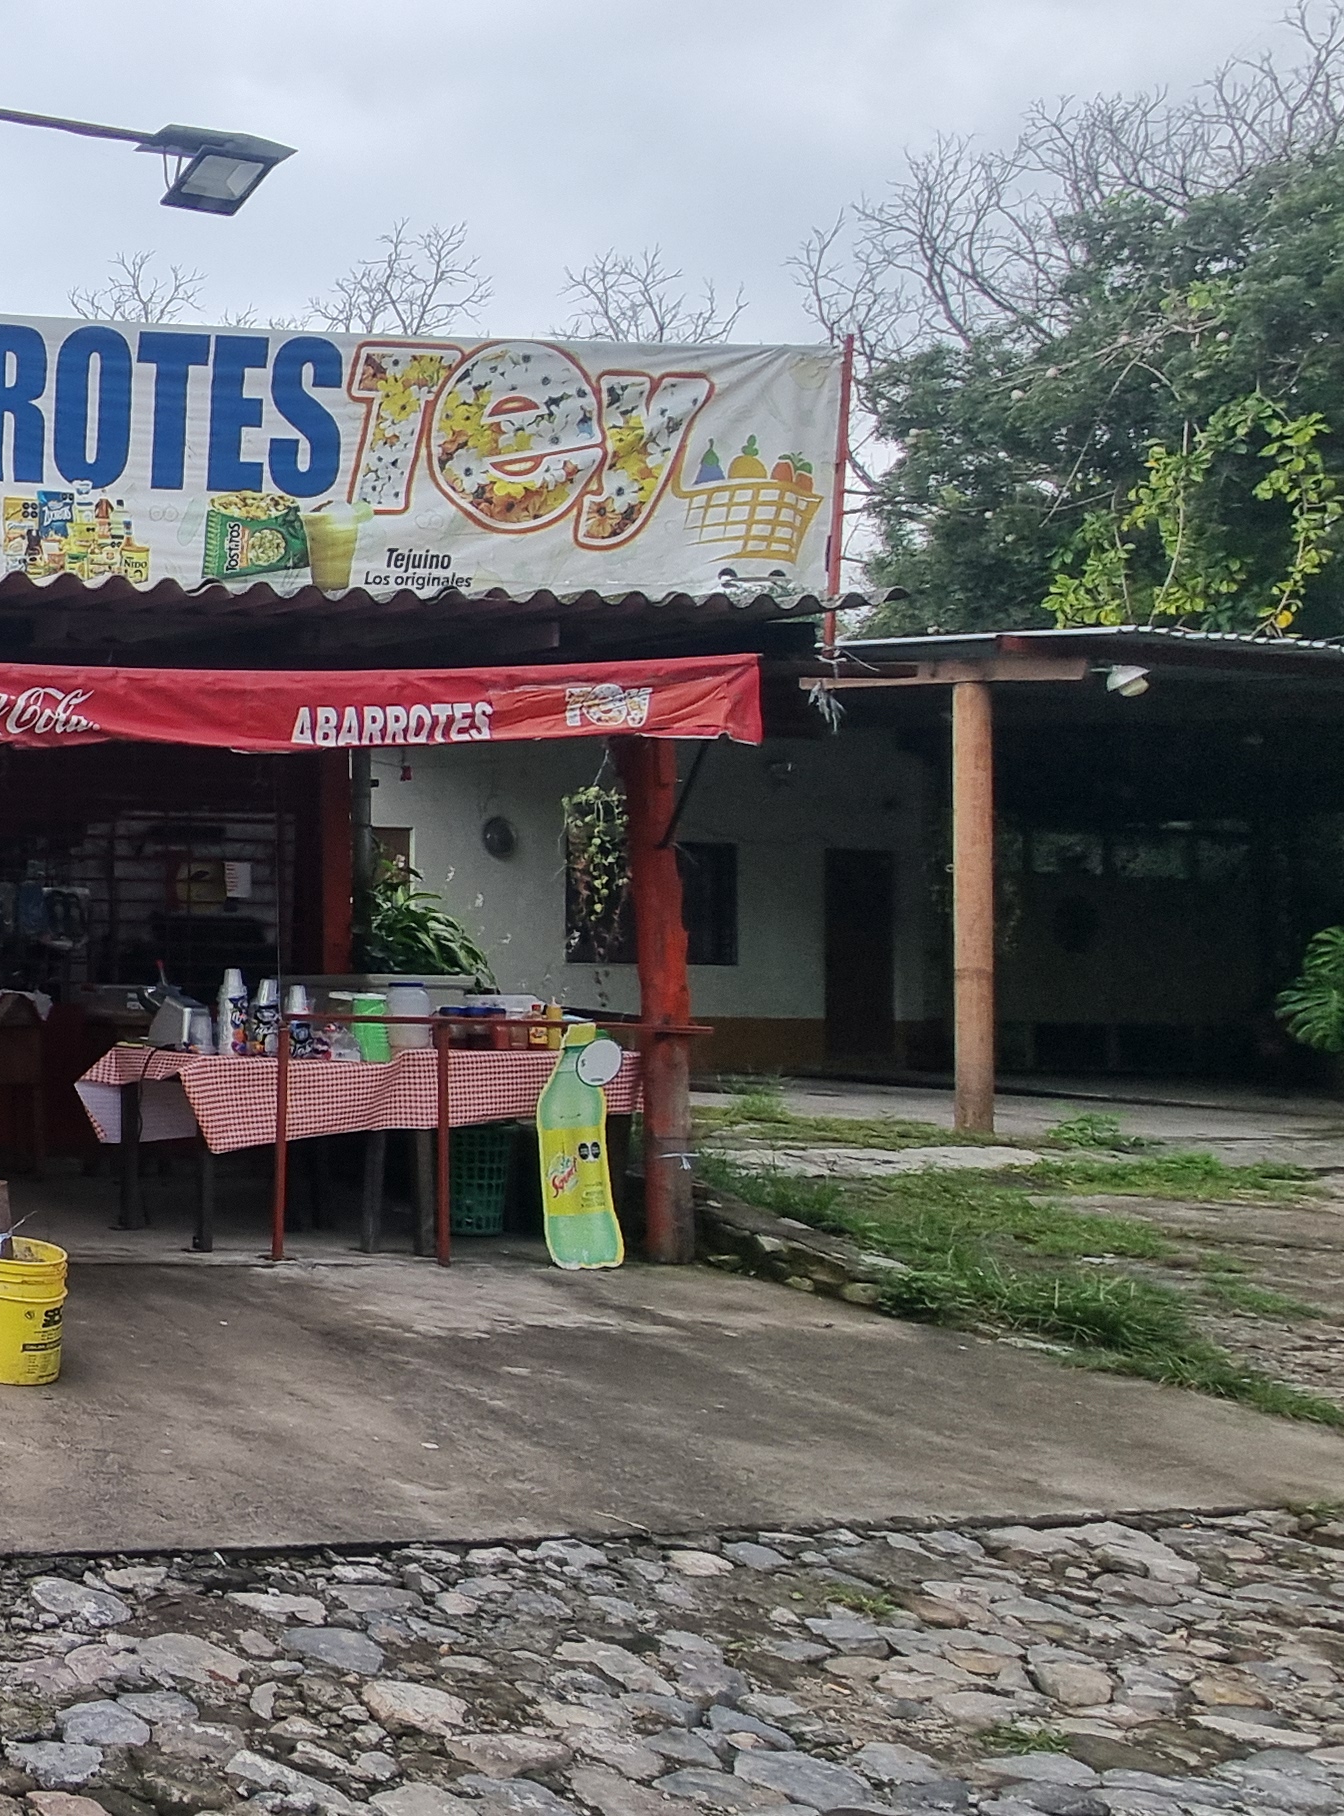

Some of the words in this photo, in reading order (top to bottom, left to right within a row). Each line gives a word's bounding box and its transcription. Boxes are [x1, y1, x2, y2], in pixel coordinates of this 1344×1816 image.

[386, 547, 452, 572] Tejuino
[364, 571, 391, 587] Los
[393, 571, 473, 588] originales
[291, 702, 494, 746] ABARROTES
